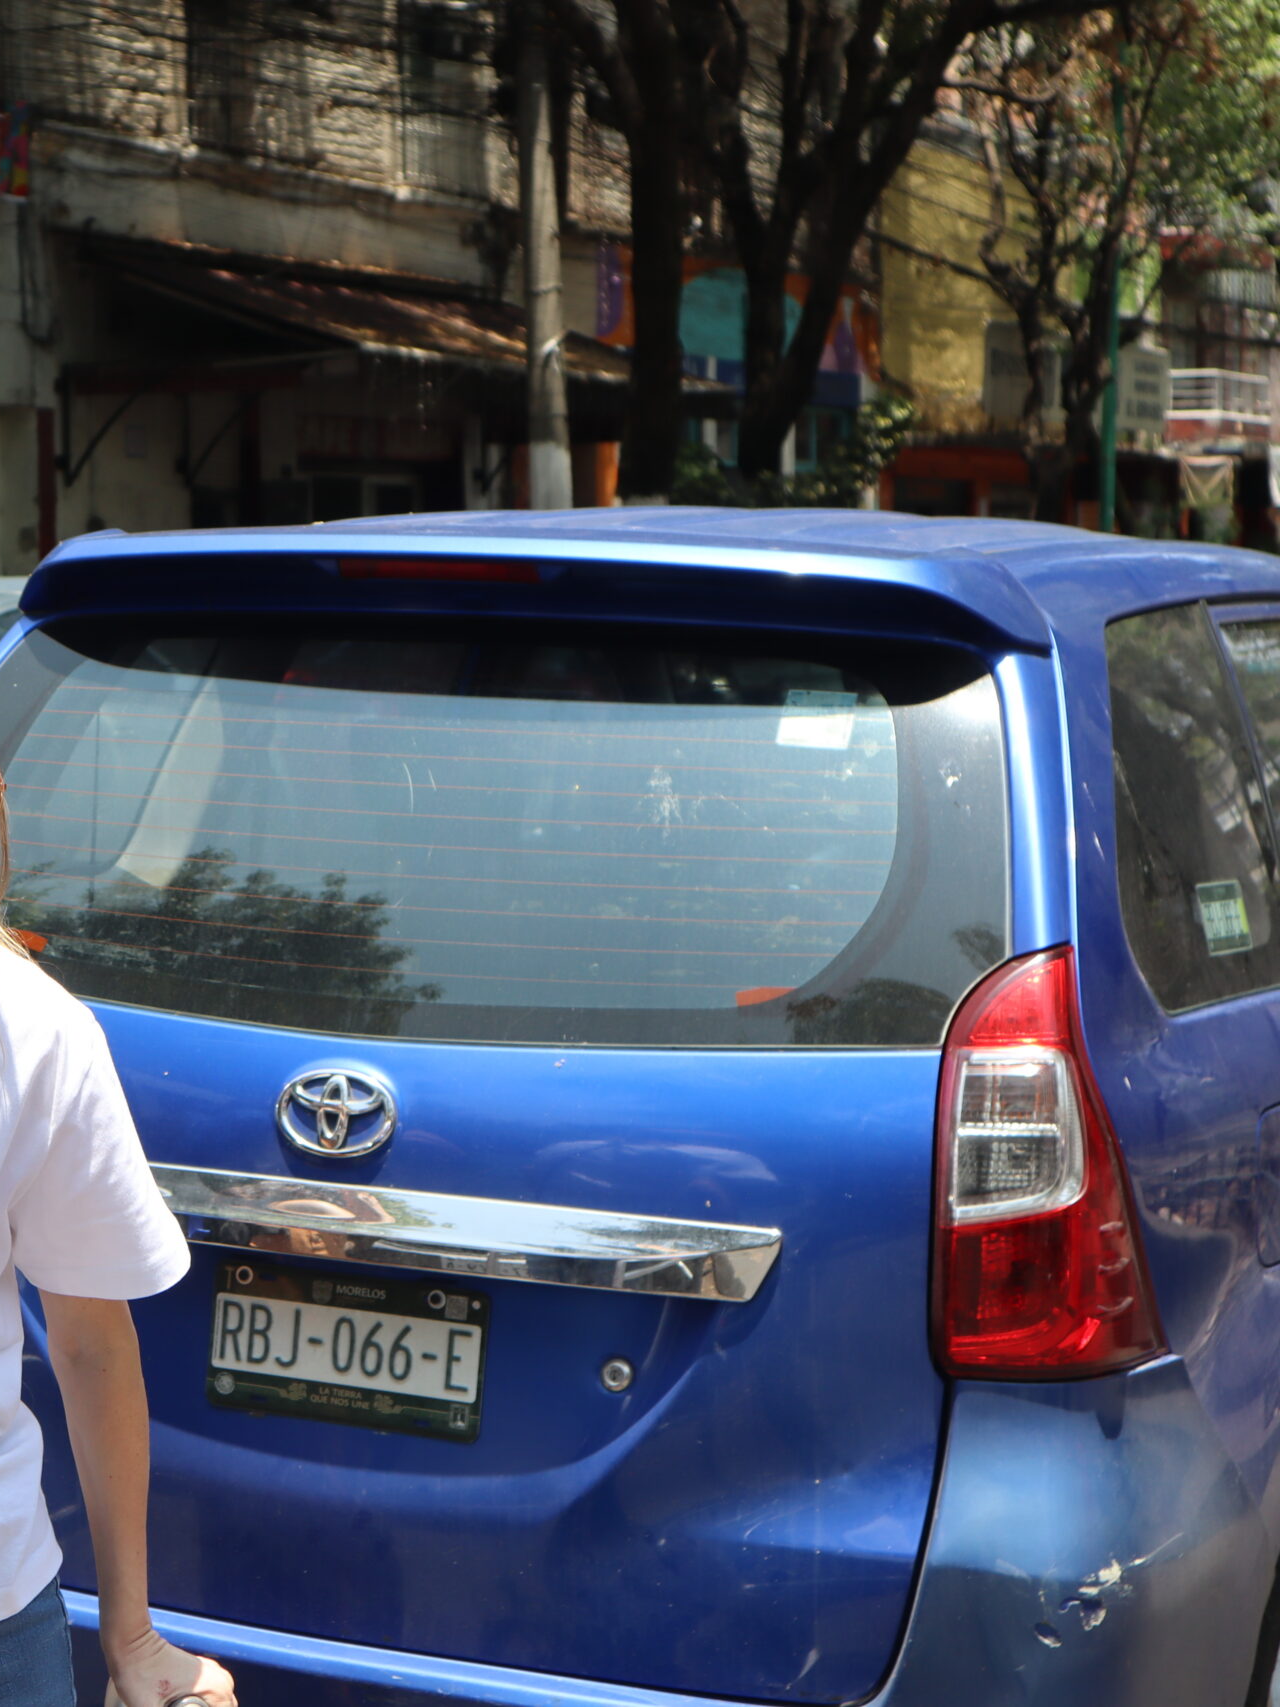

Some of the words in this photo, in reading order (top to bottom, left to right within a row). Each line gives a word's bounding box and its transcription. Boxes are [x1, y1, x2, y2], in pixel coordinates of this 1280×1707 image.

[335, 1284, 387, 1300] MORELOS
[219, 1300, 473, 1393] RBJ-066-E
[319, 1386, 330, 1395] LA
[331, 1387, 362, 1399] TIERRA
[310, 1394, 328, 1404] QUE
[330, 1397, 349, 1407] NOS
[351, 1400, 370, 1410] UNE
